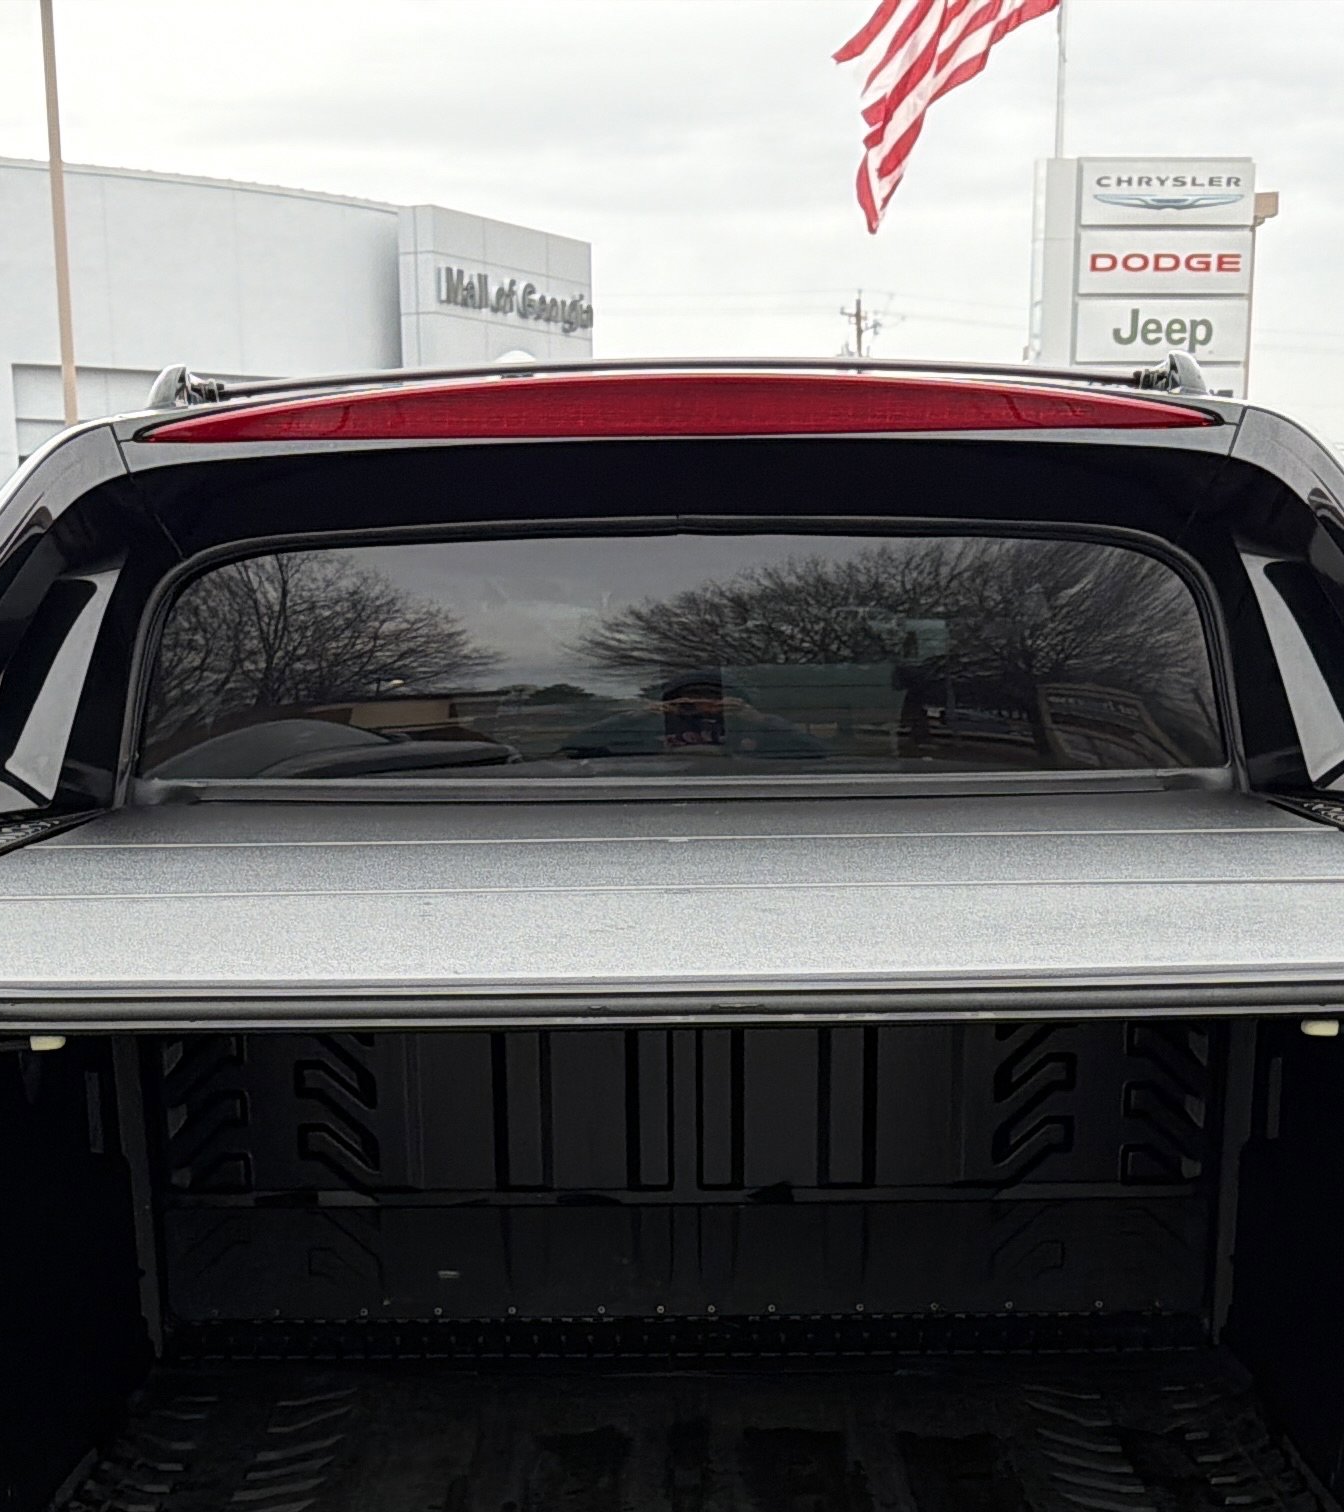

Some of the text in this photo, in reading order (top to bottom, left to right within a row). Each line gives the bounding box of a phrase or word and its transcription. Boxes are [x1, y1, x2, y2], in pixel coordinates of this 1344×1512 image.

[1095, 175, 1243, 188] CHRYSLER
[1089, 252, 1243, 273] DODGE
[437, 266, 594, 334] Mall of Georgia
[1112, 308, 1214, 353] Jeep
